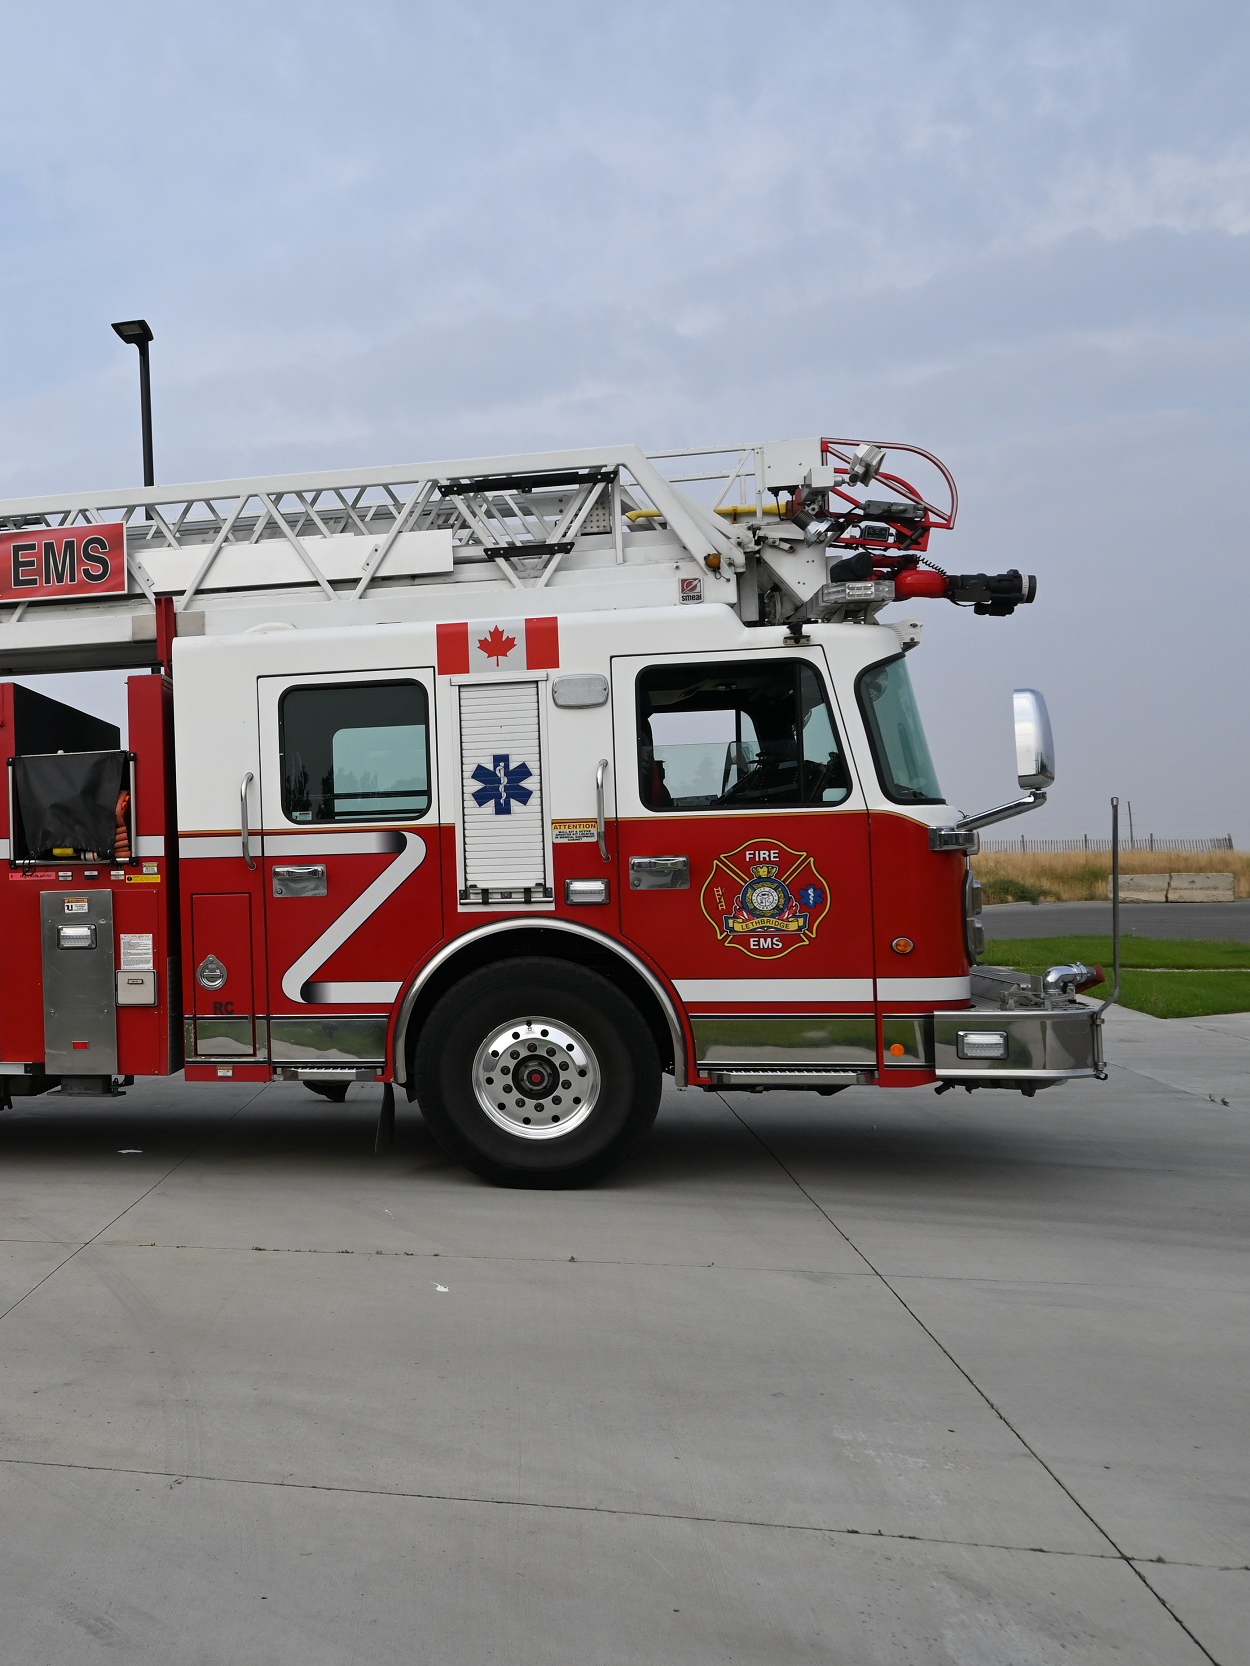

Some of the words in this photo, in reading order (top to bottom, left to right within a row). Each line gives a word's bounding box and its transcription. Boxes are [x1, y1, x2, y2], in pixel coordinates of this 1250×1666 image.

[11, 535, 112, 587] EMS
[745, 850, 780, 862] FIRE
[741, 918, 791, 931] LETHBRIDGE
[750, 938, 783, 949] EMS
[213, 1001, 235, 1015] RC
